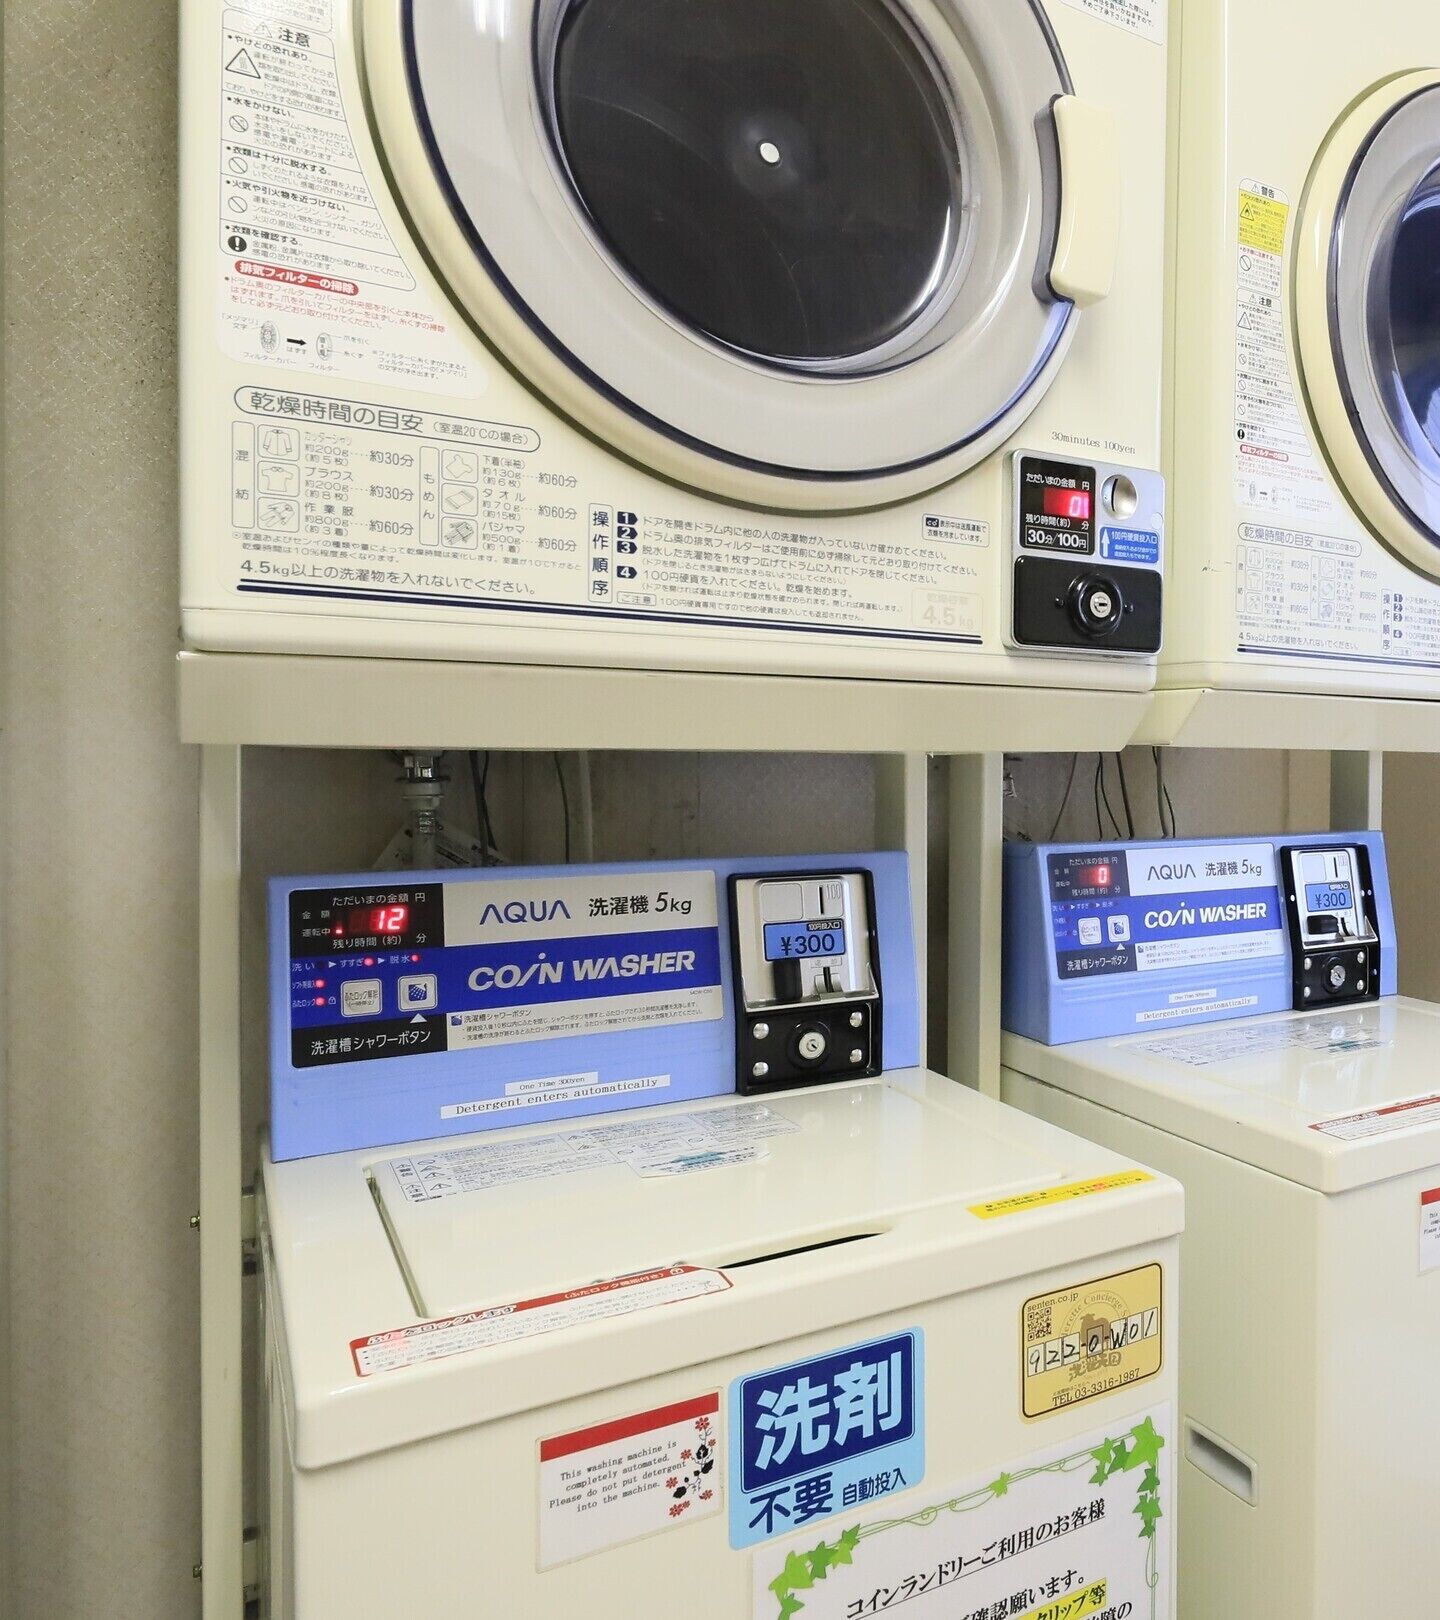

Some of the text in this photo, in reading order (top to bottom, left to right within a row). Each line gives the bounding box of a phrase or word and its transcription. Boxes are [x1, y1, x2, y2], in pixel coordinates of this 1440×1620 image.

[278, 27, 311, 48] 注意
[233, 97, 295, 118] 水をかけない。
[233, 147, 332, 176] 衣類は十分に脱水する。
[232, 180, 349, 212] 火気や引火物を近づけない。
[232, 225, 303, 246] 衣類を確認する。
[239, 262, 356, 294] 排気フィルターの掃除
[251, 392, 424, 433] 乾燥時間の目安
[1051, 431, 1136, 455] 30minutes 100yen
[369, 450, 415, 467] 約30分
[305, 466, 354, 482] ブラウス
[538, 472, 578, 488] 約60分
[1025, 473, 1090, 491] ただいまの金額 円
[369, 484, 415, 501] 約30分
[423, 472, 435, 520] もめん
[483, 489, 526, 502] タオル
[538, 505, 578, 520] 約60分
[369, 520, 414, 536] 約60分
[482, 522, 526, 534] パジャマ
[1081, 521, 1089, 531] 分
[1244, 526, 1314, 548] 乾燥時間の目安
[538, 537, 577, 552] 約60分
[1027, 529, 1087, 549] 30分/100円
[592, 511, 609, 596] 操作順序
[240, 560, 536, 595] 4.5kg以上の洗濯物を入れないでください。
[1098, 867, 1108, 884] 0
[1148, 858, 1262, 881] AQUA 洗濯機 5kg
[332, 892, 426, 906] ただいまの金額 円
[479, 891, 692, 926] AQUA 洗濯機 5kg
[1315, 892, 1346, 908] ¥300
[378, 908, 405, 930] 12
[1144, 902, 1267, 929] COIN WASHER
[416, 933, 427, 943] 分
[781, 934, 835, 956] ¥300
[340, 958, 364, 967] すすぎ
[390, 955, 410, 964] 脱水
[467, 949, 696, 992] COIN WASHER
[1066, 955, 1129, 971] 洗濯槽シャワーボタン
[463, 1009, 531, 1024] 洗濯槽シャワーボタン
[1143, 998, 1251, 1020] Detergent enters automatically
[311, 1030, 431, 1056] 洗濯槽シャワーボタン
[456, 1078, 658, 1115] Detergent enters automatically
[1052, 1391, 1073, 1407] TEL
[1074, 1368, 1141, 1398] 03-3316-1987
[754, 1351, 903, 1472] 洗剤
[560, 1441, 677, 1481] This washing machine is
[565, 1454, 670, 1492] completely automated.
[549, 1461, 687, 1509] Please do not put detergent
[576, 1482, 661, 1512] into the machine.
[748, 1467, 908, 1535] 不要 自動投入
[846, 1497, 1106, 1620] コインランドリーご利用のお客様
